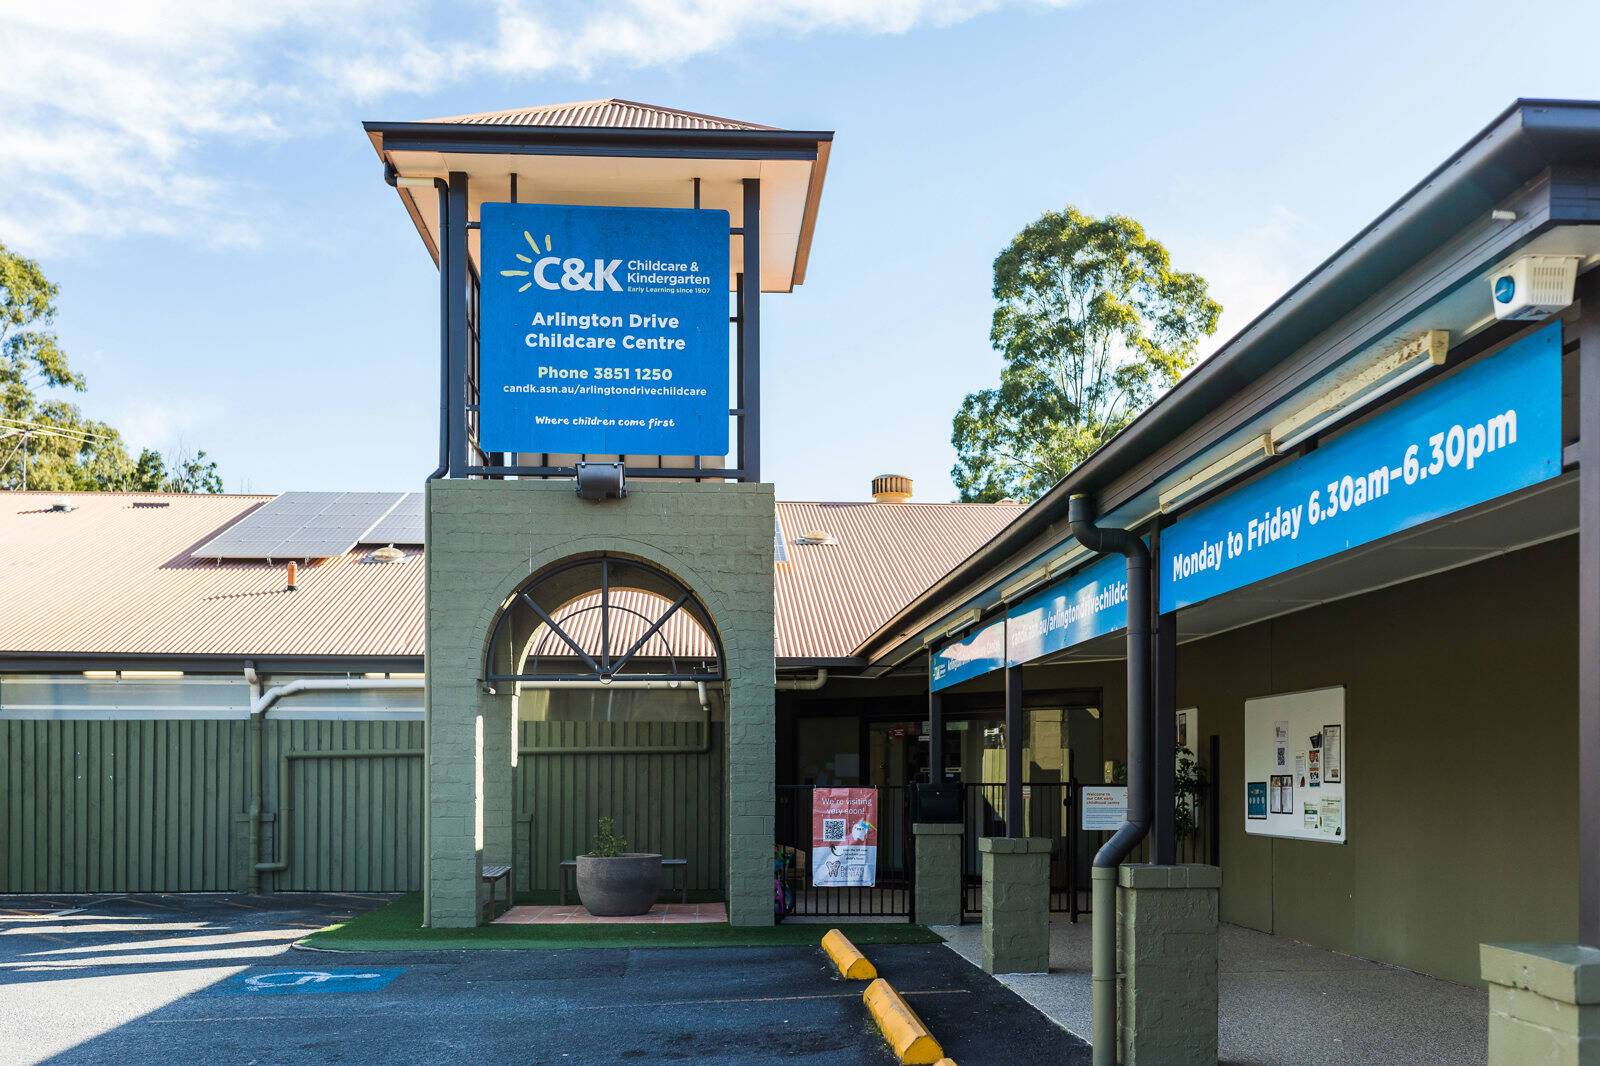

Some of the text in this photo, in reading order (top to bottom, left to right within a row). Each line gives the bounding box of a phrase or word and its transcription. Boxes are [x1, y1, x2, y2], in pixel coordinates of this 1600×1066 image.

[627, 260, 699, 272] Childcare &
[534, 256, 624, 292] C&K
[627, 273, 710, 286] Kindergarten
[646, 286, 675, 294] Learning
[531, 311, 680, 330] Arlington Drive
[525, 333, 686, 350] Childcare Centre
[538, 366, 673, 381] Phone 3851 1250
[503, 383, 707, 396] candk.asn.au/arlingtondrivechildcare
[535, 415, 675, 430] Where children come first
[1173, 541, 1223, 582] Monday
[1227, 531, 1243, 559] to
[1247, 504, 1303, 551] Friday
[847, 797, 872, 807] visiting
